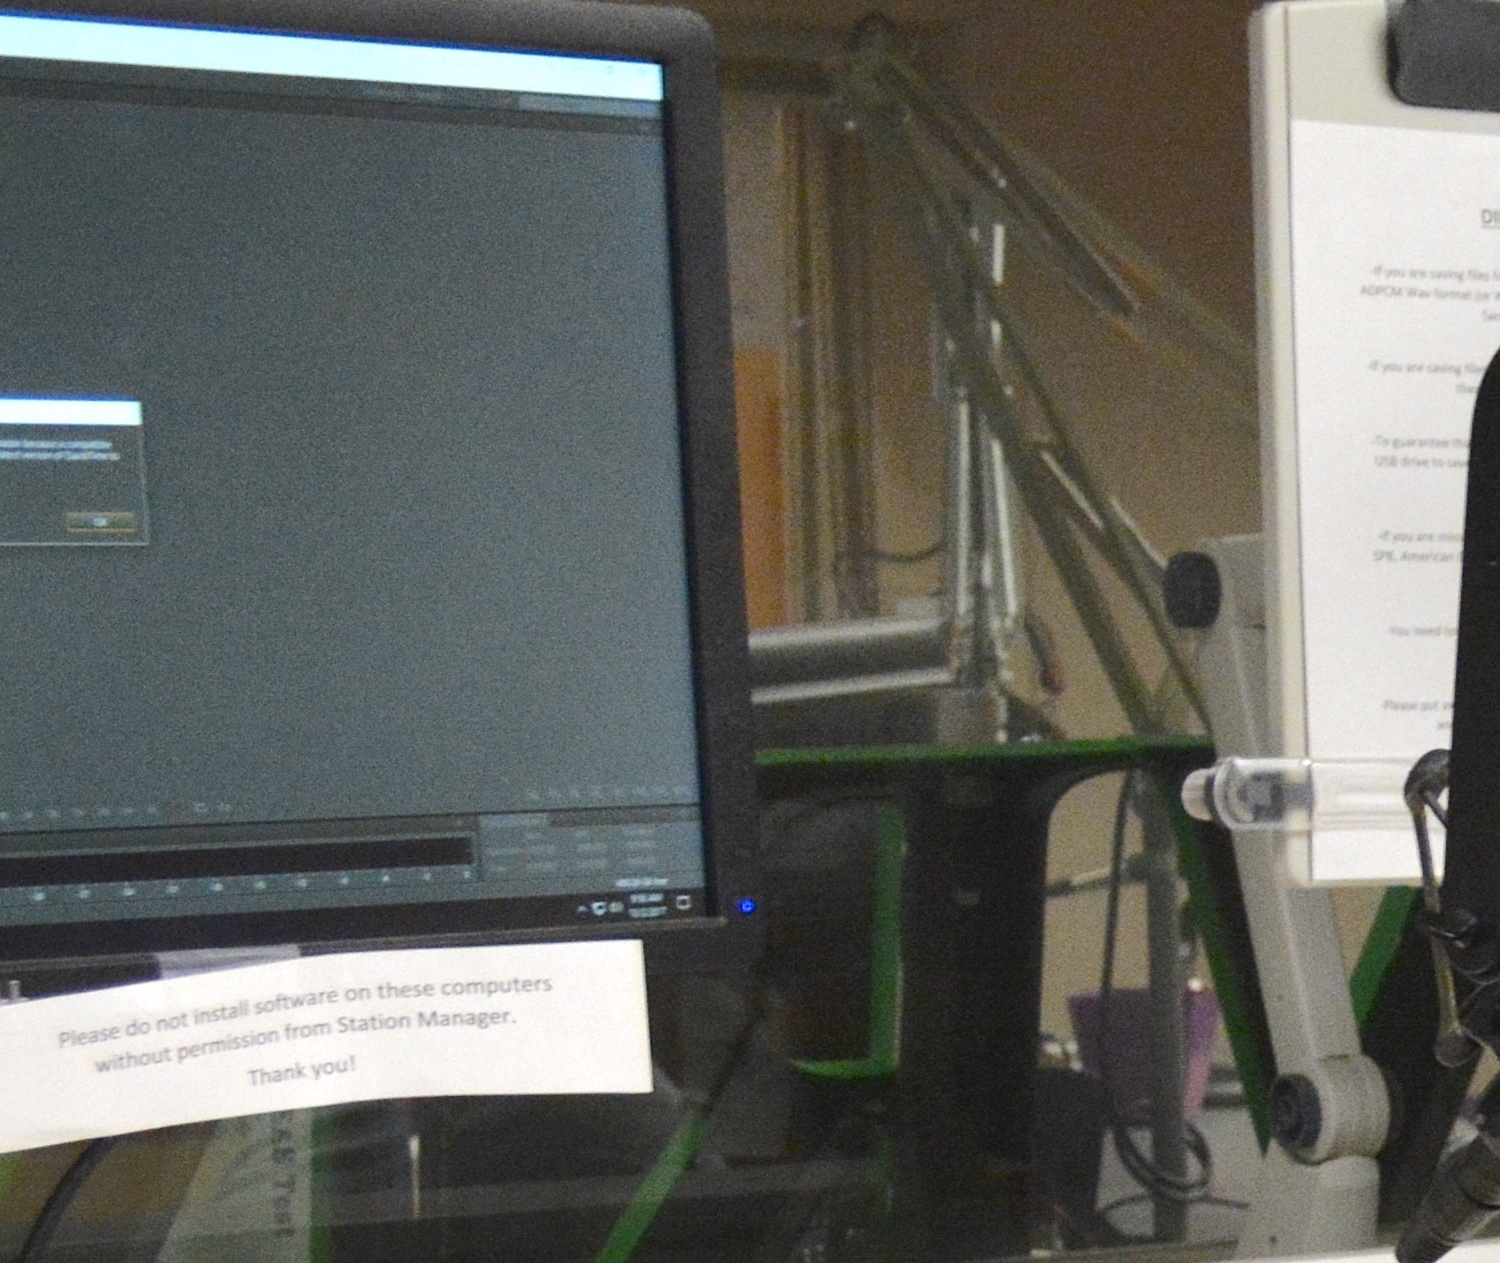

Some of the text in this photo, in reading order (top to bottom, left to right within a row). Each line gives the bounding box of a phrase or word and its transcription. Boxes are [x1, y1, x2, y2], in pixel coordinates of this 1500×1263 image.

[58, 976, 553, 1049] Please do not install software on these computers
[94, 1008, 517, 1075] without permission from Station Manager.
[248, 1055, 358, 1087] Thank you!
